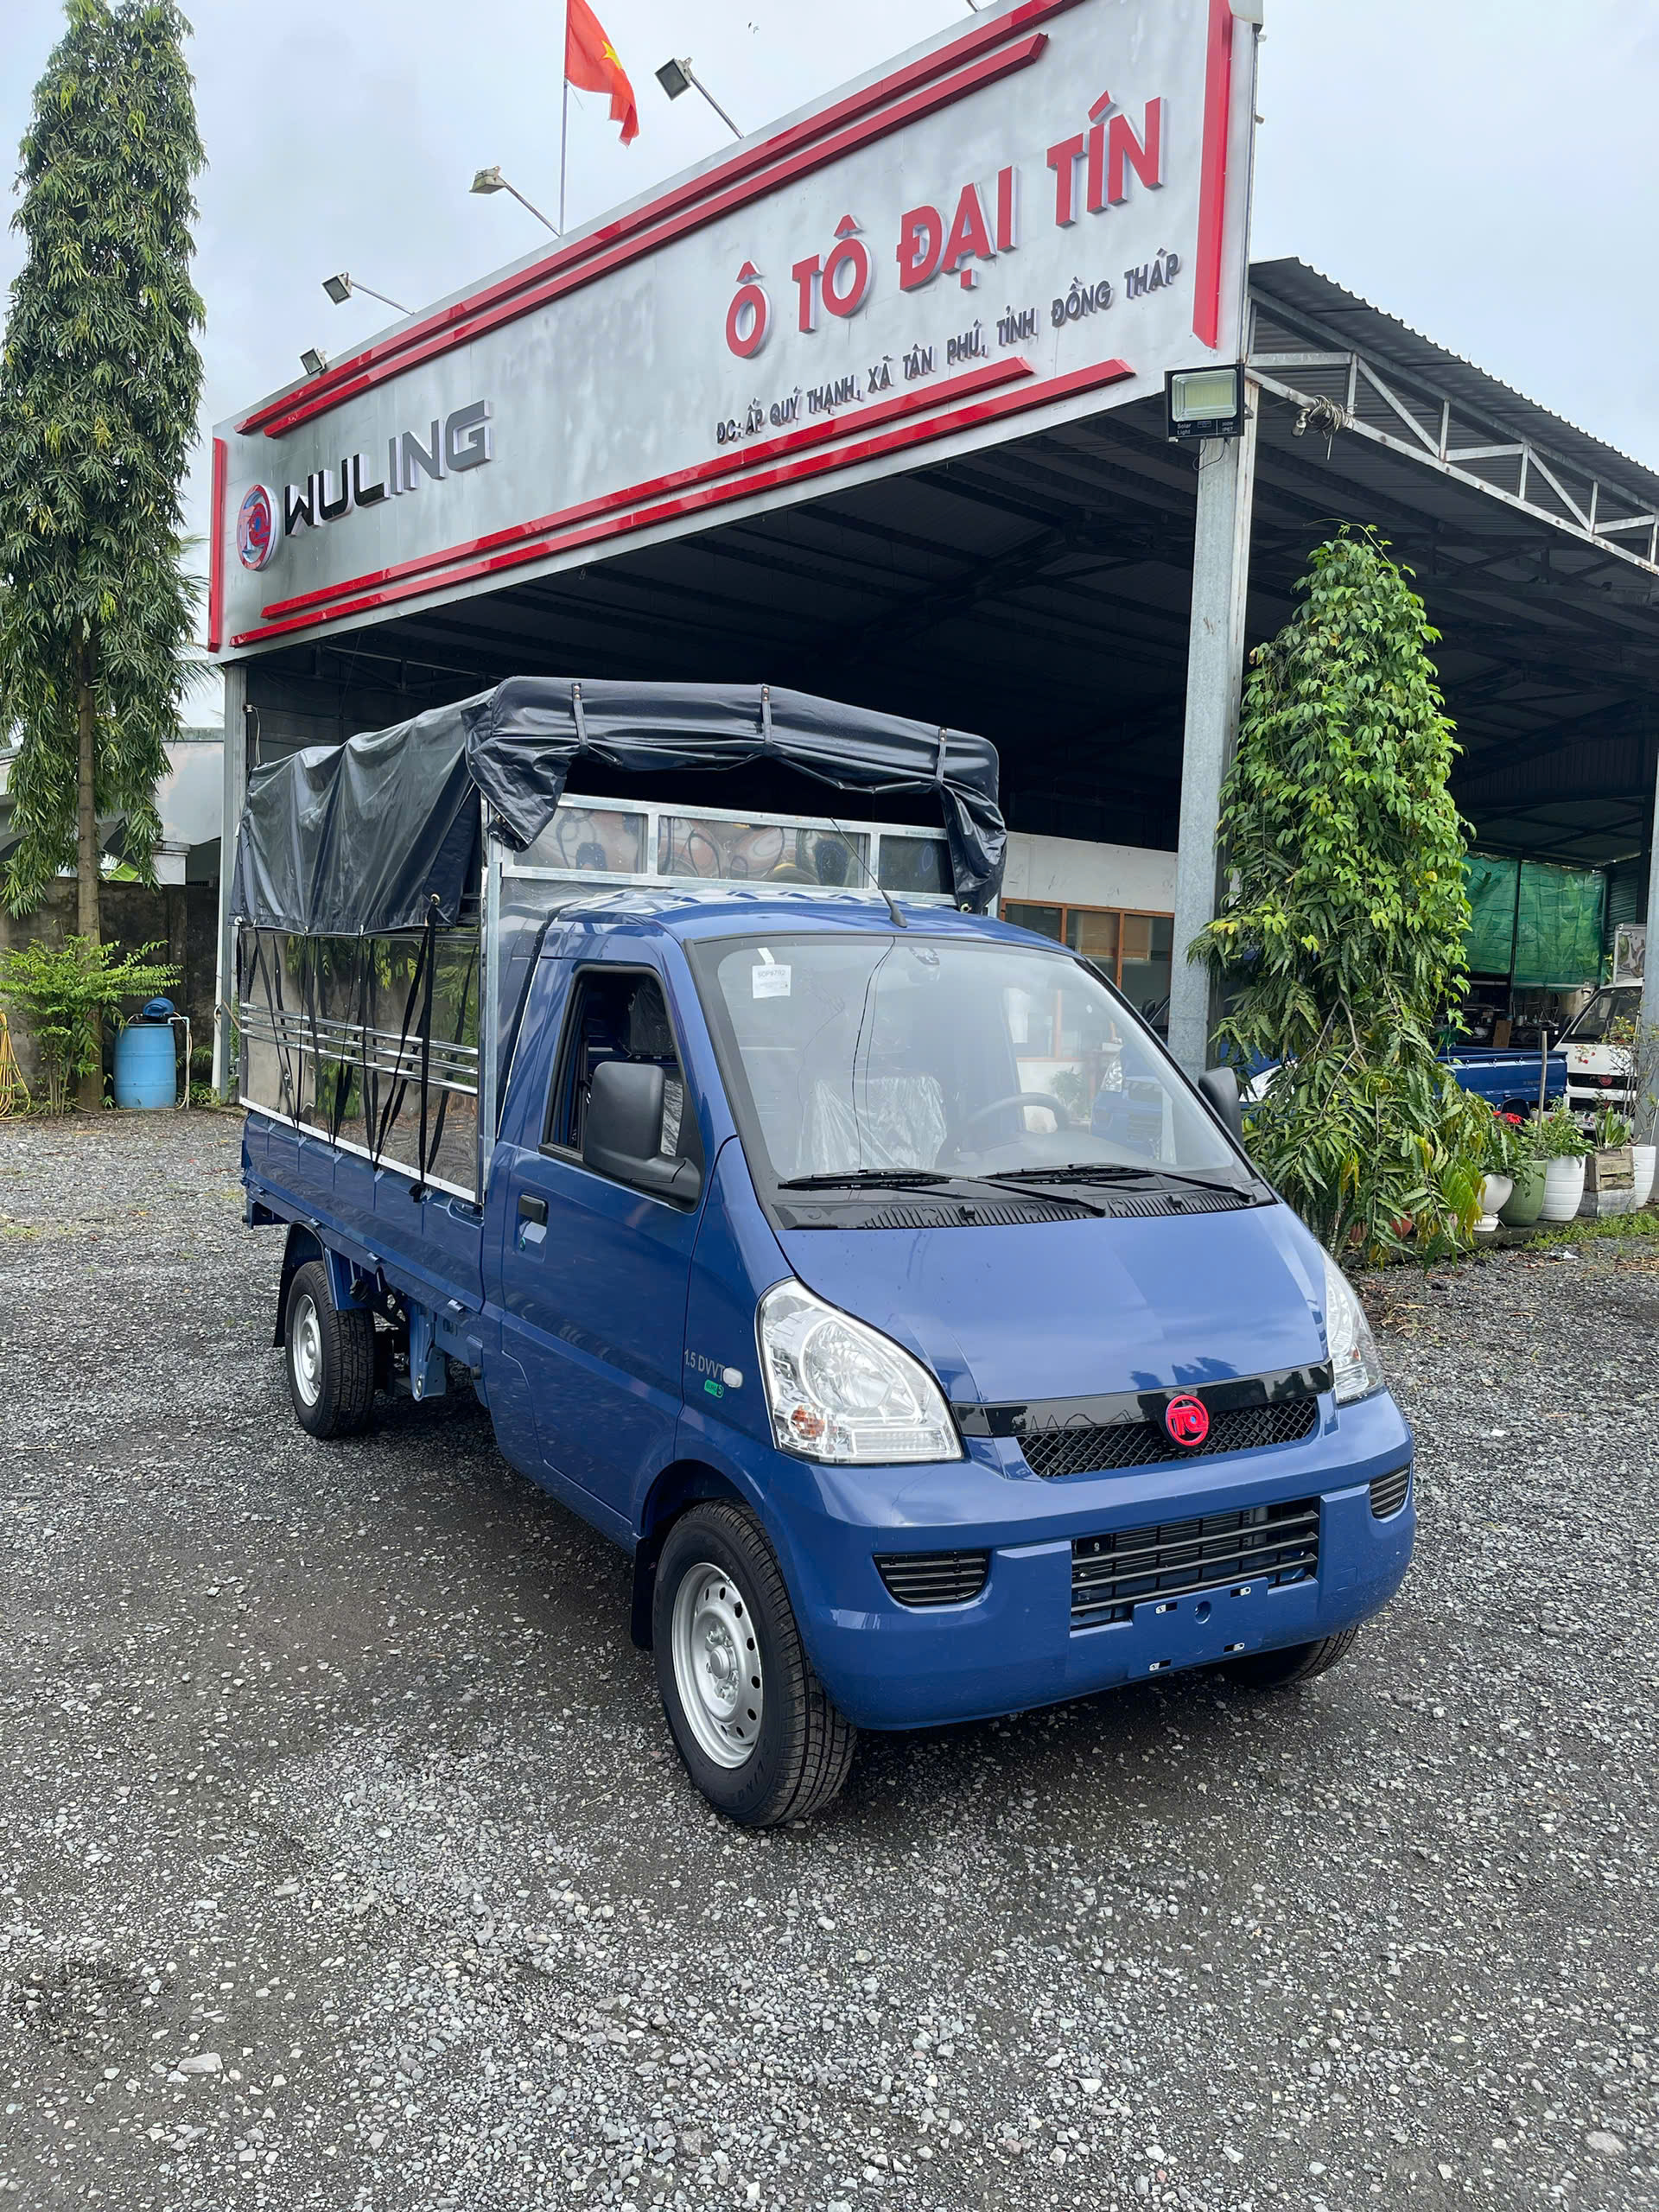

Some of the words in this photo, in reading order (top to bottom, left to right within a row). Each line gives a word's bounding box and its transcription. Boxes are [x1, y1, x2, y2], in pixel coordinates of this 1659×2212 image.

[726, 260, 772, 359] Ô
[792, 215, 871, 334] TÔ
[896, 165, 1016, 290] ĐẠI
[1046, 90, 1165, 227] TÍN
[746, 397, 764, 435] ẤP
[770, 386, 801, 427] QUÝ
[807, 374, 862, 415] THẠNH,
[868, 355, 893, 393] XÃ
[903, 343, 935, 380] TÂN
[947, 319, 988, 365] PHÚ,
[996, 305, 1037, 346] TỈNH
[1051, 276, 1112, 327] ĐỒNG
[1124, 248, 1181, 299] THÁP
[285, 399, 491, 537] WULING
[684, 1349, 696, 1368] 1.5
[698, 1355, 725, 1382] DVVT
